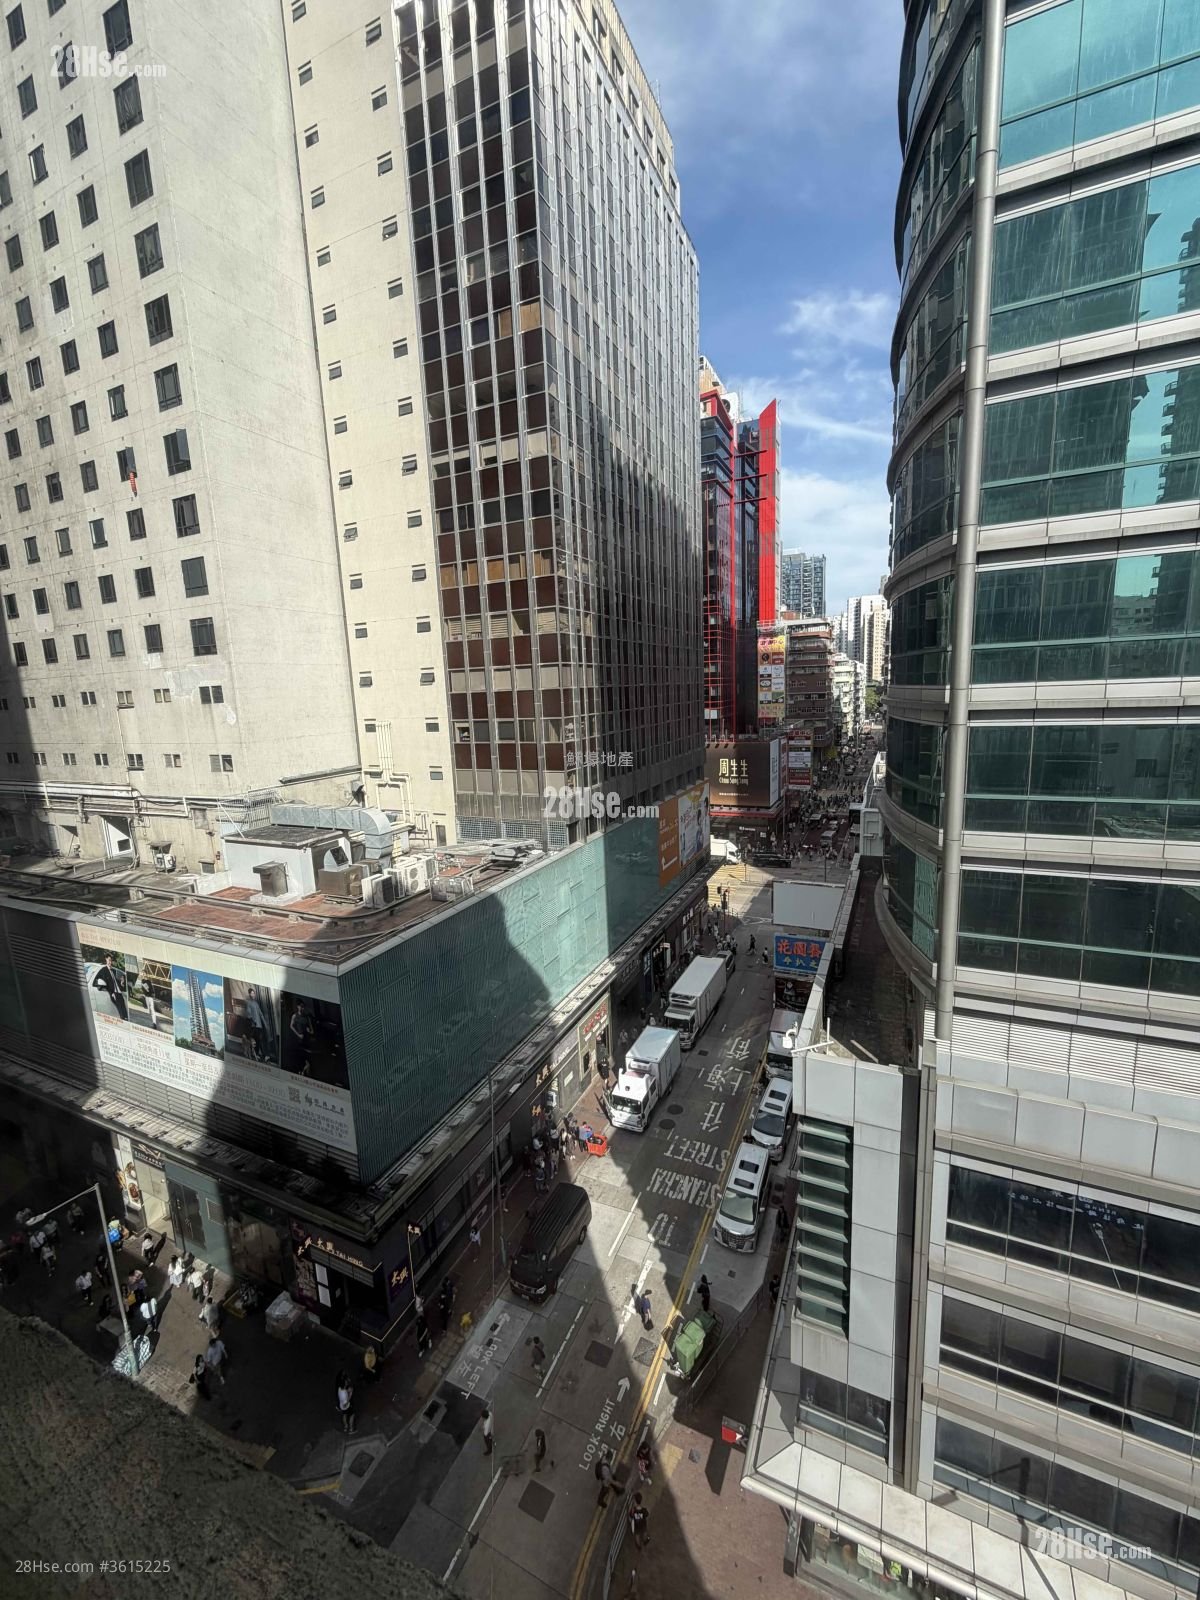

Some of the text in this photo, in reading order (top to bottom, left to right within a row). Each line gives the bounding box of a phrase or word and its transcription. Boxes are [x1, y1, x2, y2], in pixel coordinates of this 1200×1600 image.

[719, 758, 748, 777] 周生生
[726, 1036, 750, 1061] 街
[704, 1063, 751, 1096] 上海
[700, 1101, 726, 1132] 往
[663, 1136, 731, 1173] STREET
[646, 1168, 722, 1211] SHANGHAI
[647, 1212, 679, 1247] TO
[461, 1337, 502, 1400] LOOK LEFT
[579, 1397, 616, 1471] LOOK RIGHT
